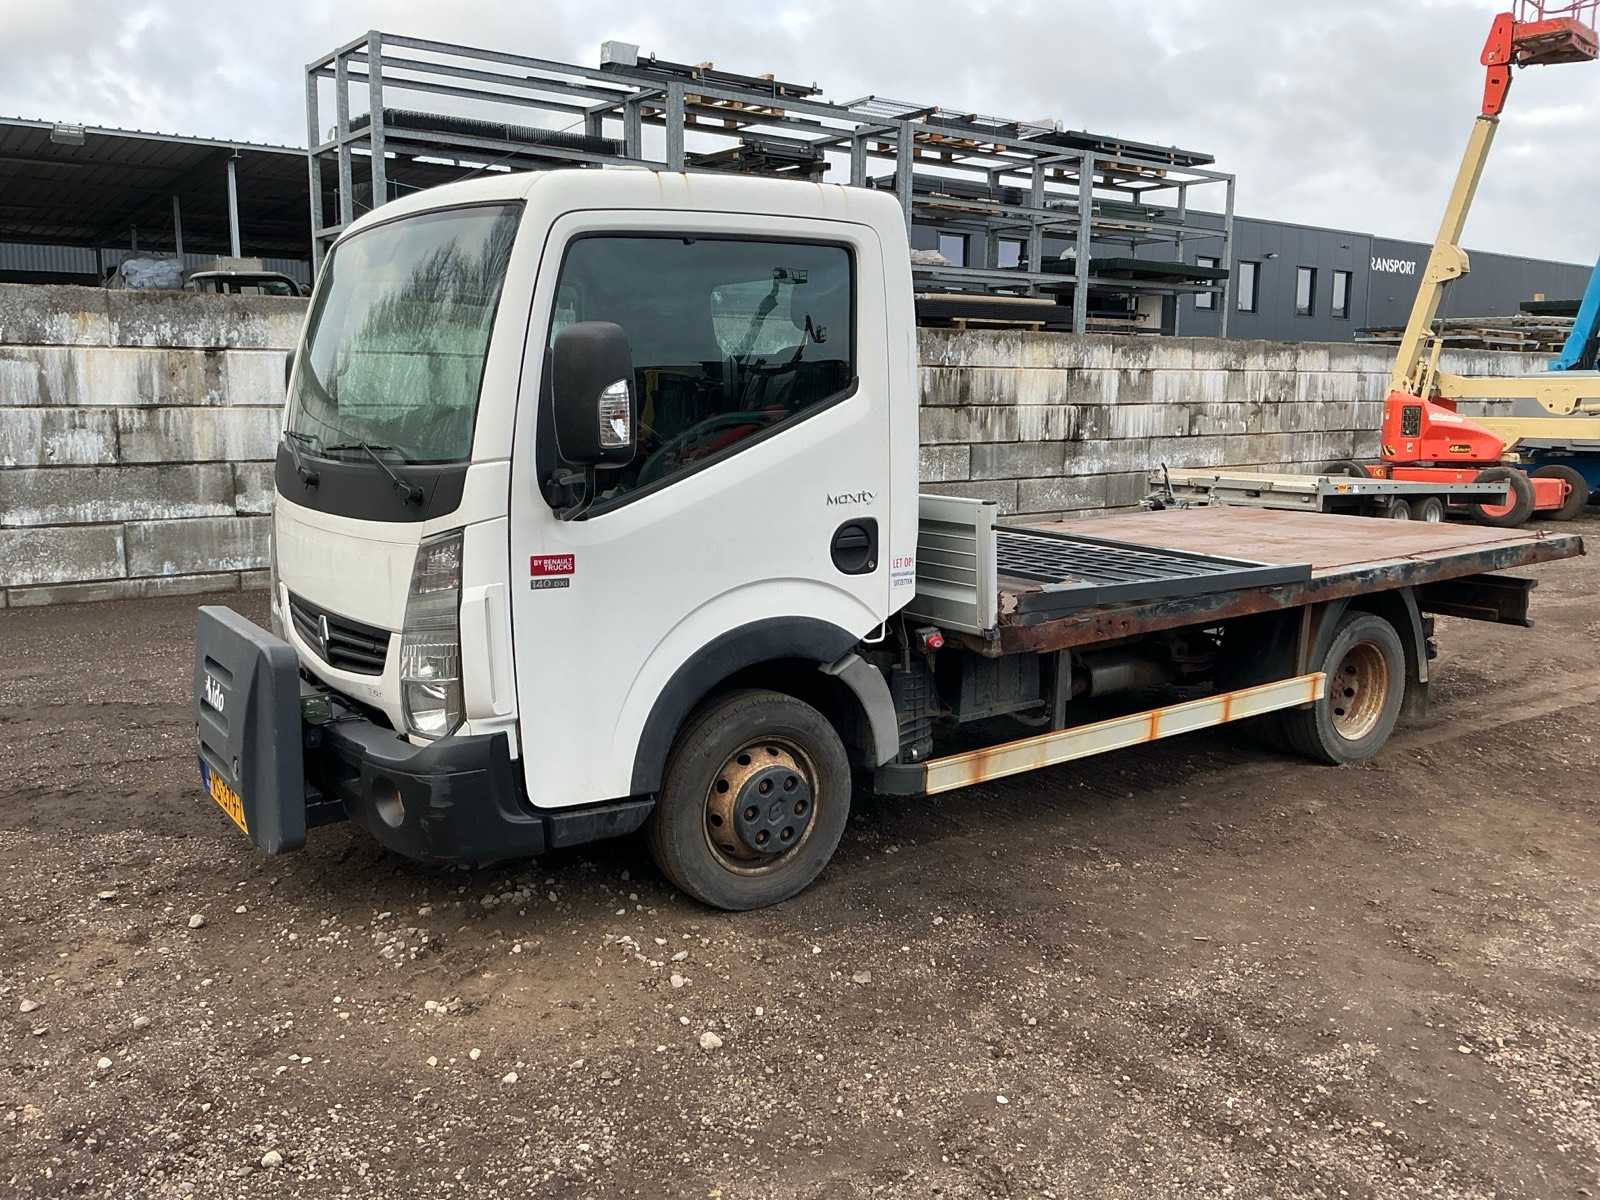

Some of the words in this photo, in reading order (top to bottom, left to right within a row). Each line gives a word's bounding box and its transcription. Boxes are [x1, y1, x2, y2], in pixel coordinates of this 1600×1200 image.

[826, 490, 875, 506] Maxity
[543, 558, 573, 566] RENAULT
[893, 558, 903, 569] LET
